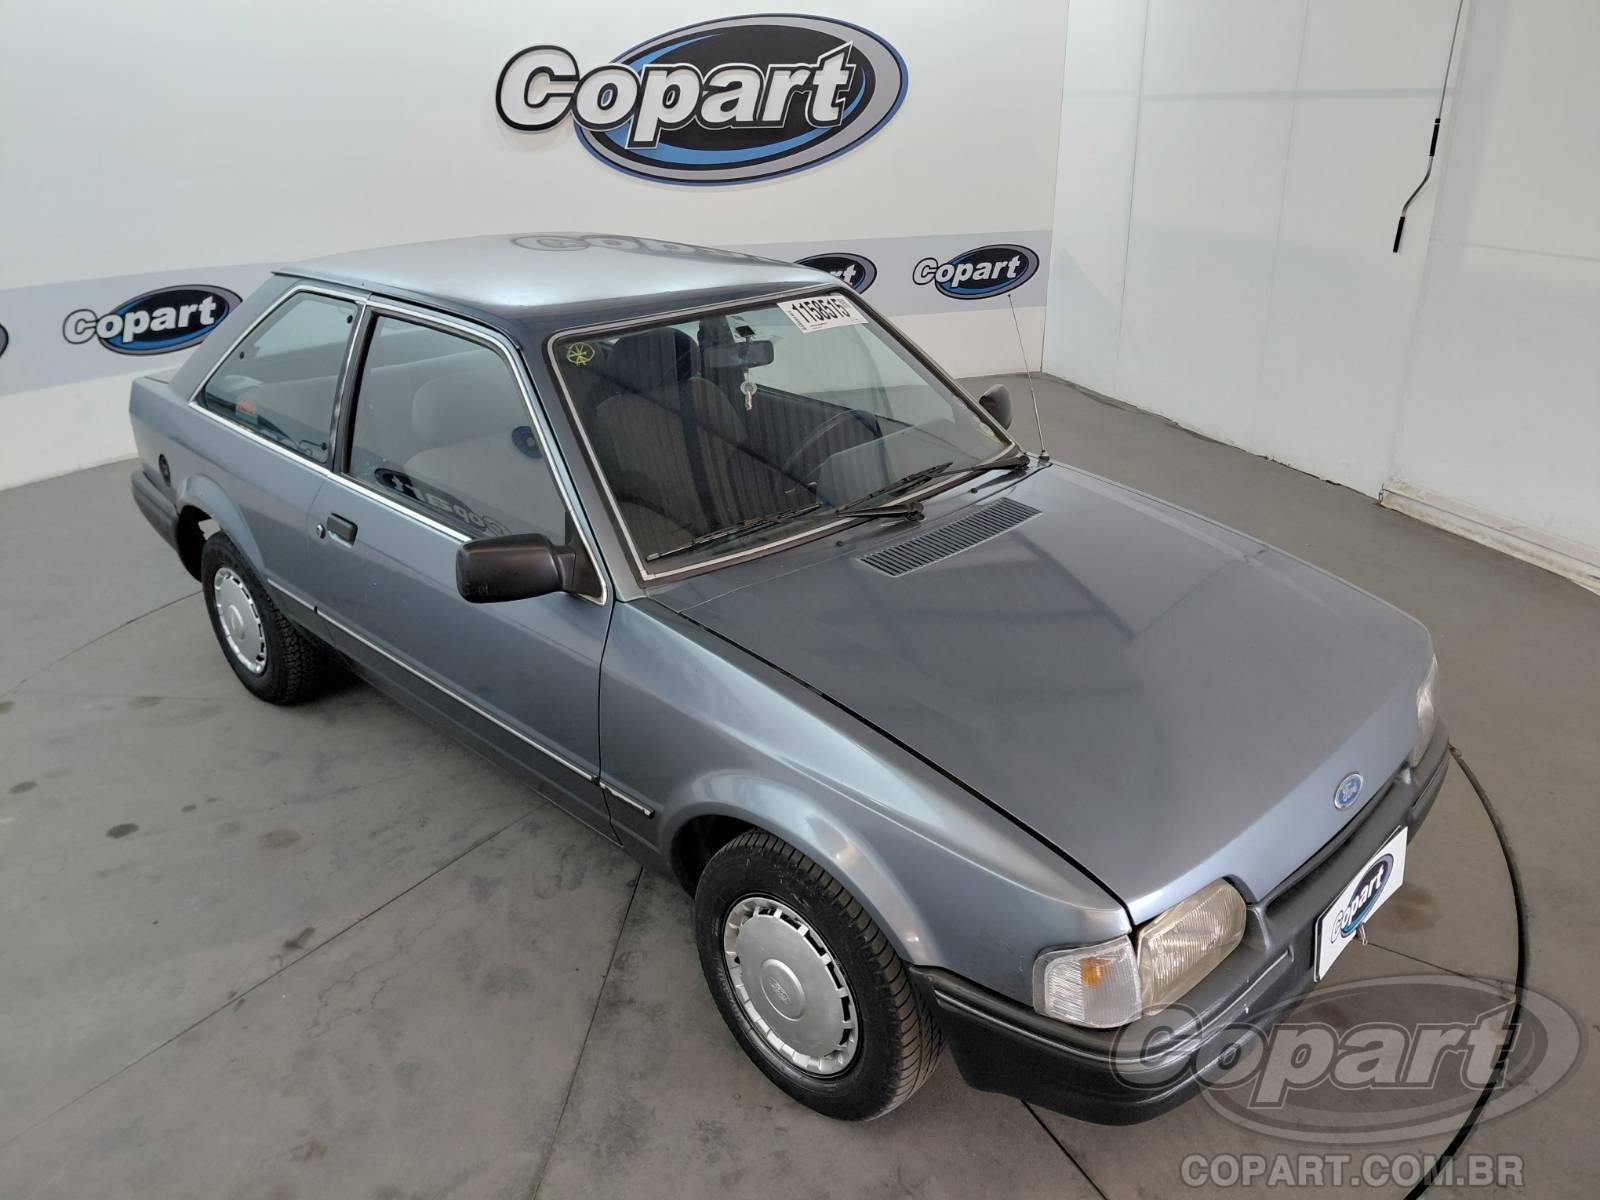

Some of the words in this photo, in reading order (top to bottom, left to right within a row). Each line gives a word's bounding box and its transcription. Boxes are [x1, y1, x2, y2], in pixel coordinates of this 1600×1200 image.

[497, 41, 857, 149] Copart
[913, 256, 1021, 287] Copart
[63, 296, 217, 343] Copart
[792, 298, 851, 323] 1158515
[1331, 864, 1385, 944] Copart
